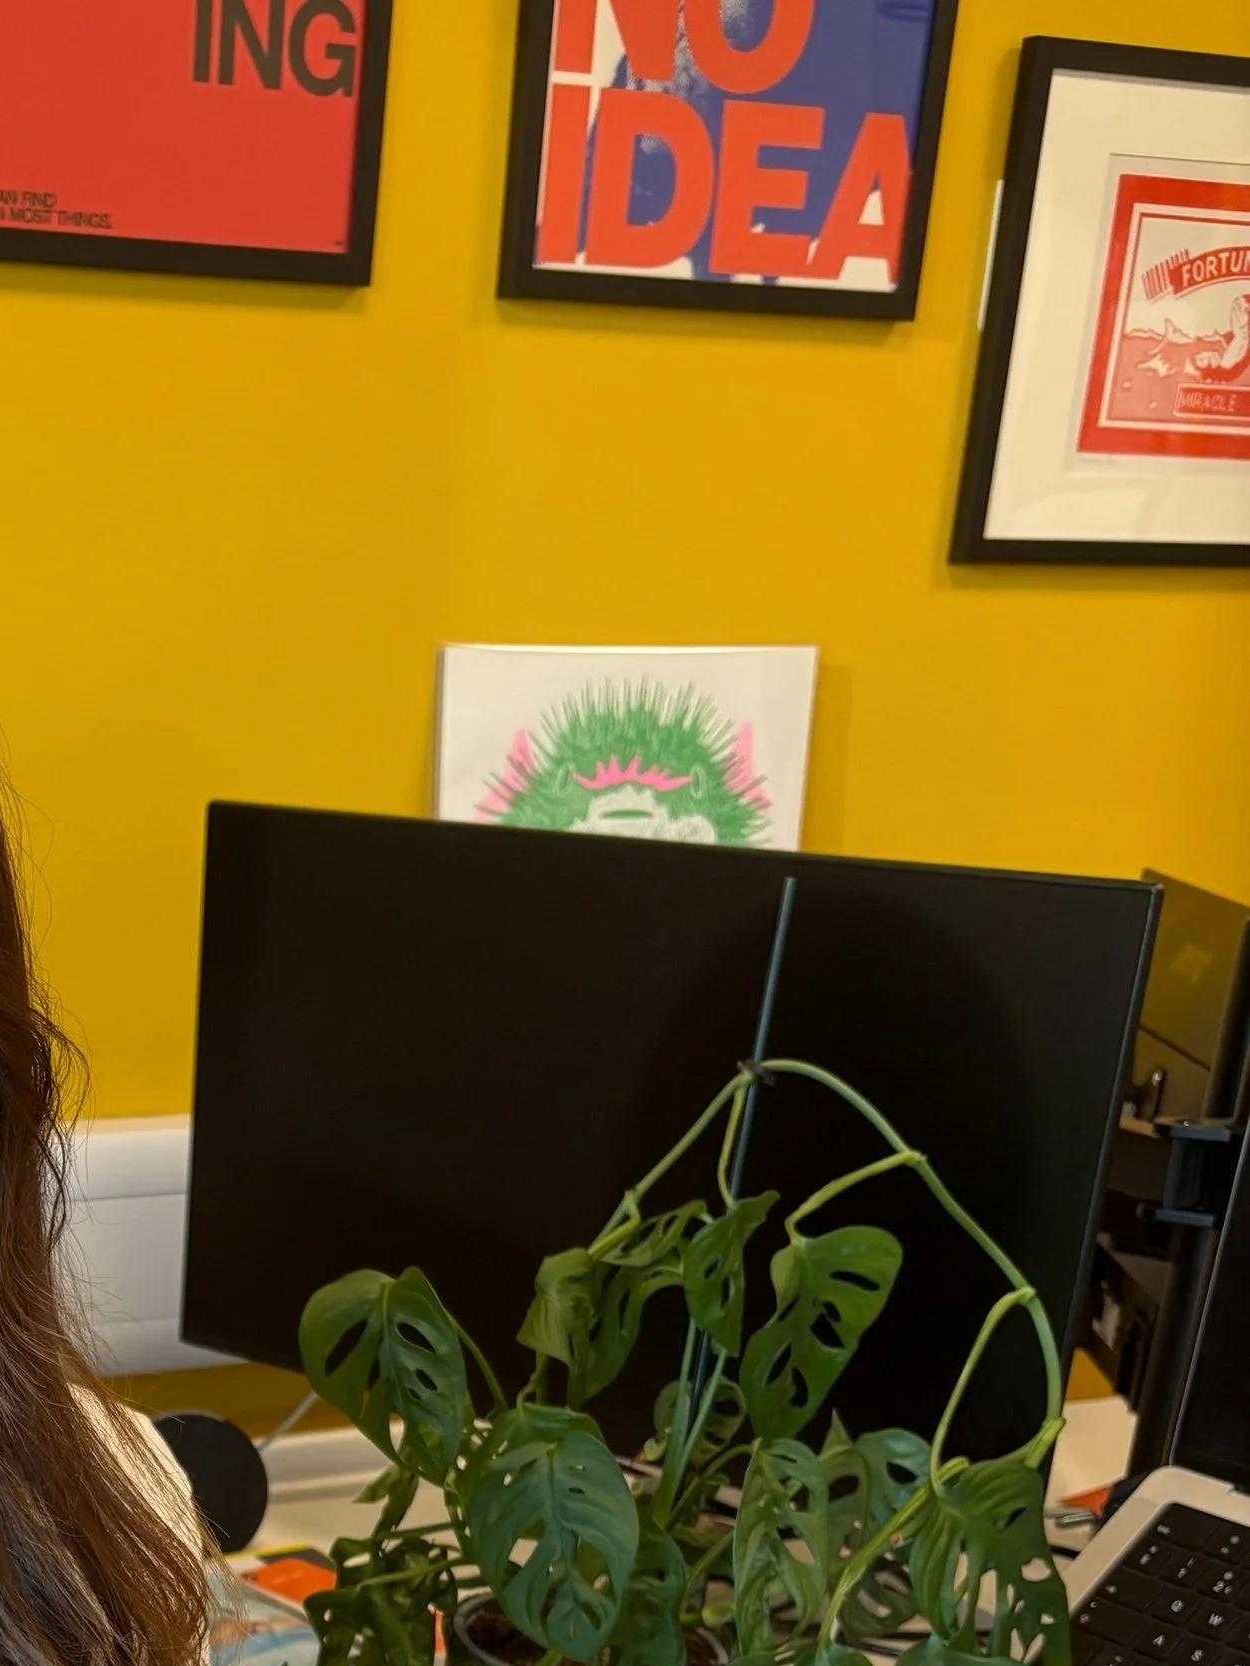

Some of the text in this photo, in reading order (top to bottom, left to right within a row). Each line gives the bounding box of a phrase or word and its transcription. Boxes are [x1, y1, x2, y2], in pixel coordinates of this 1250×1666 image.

[193, 0, 357, 98] ING
[552, 0, 814, 95] NO
[10, 207, 55, 225] MOST
[21, 190, 58, 209] FIND
[537, 84, 914, 286] IDEA
